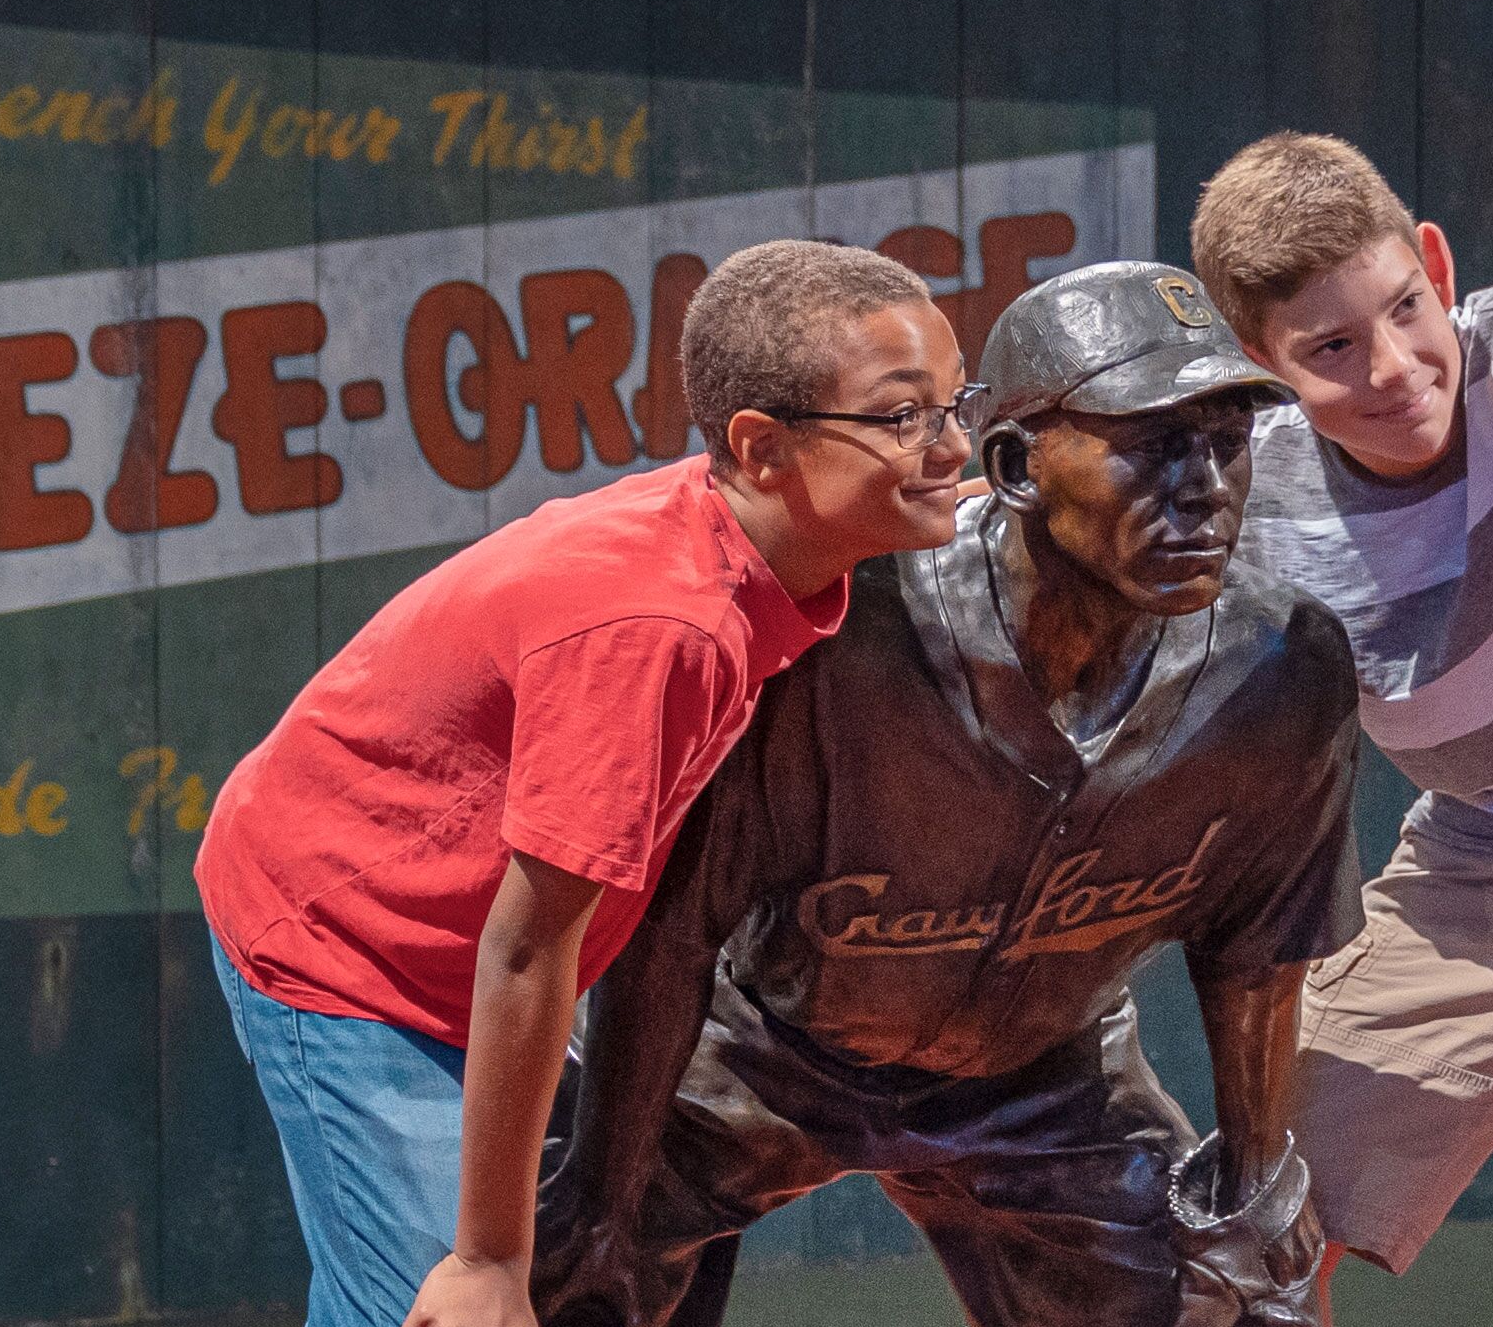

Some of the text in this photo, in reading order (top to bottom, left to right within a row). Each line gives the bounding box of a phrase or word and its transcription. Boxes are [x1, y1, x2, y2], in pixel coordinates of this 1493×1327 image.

[203, 77, 403, 186] Your
[430, 89, 650, 180] Thirst
[1154, 276, 1213, 328] C
[798, 816, 1227, 961] Crawford
